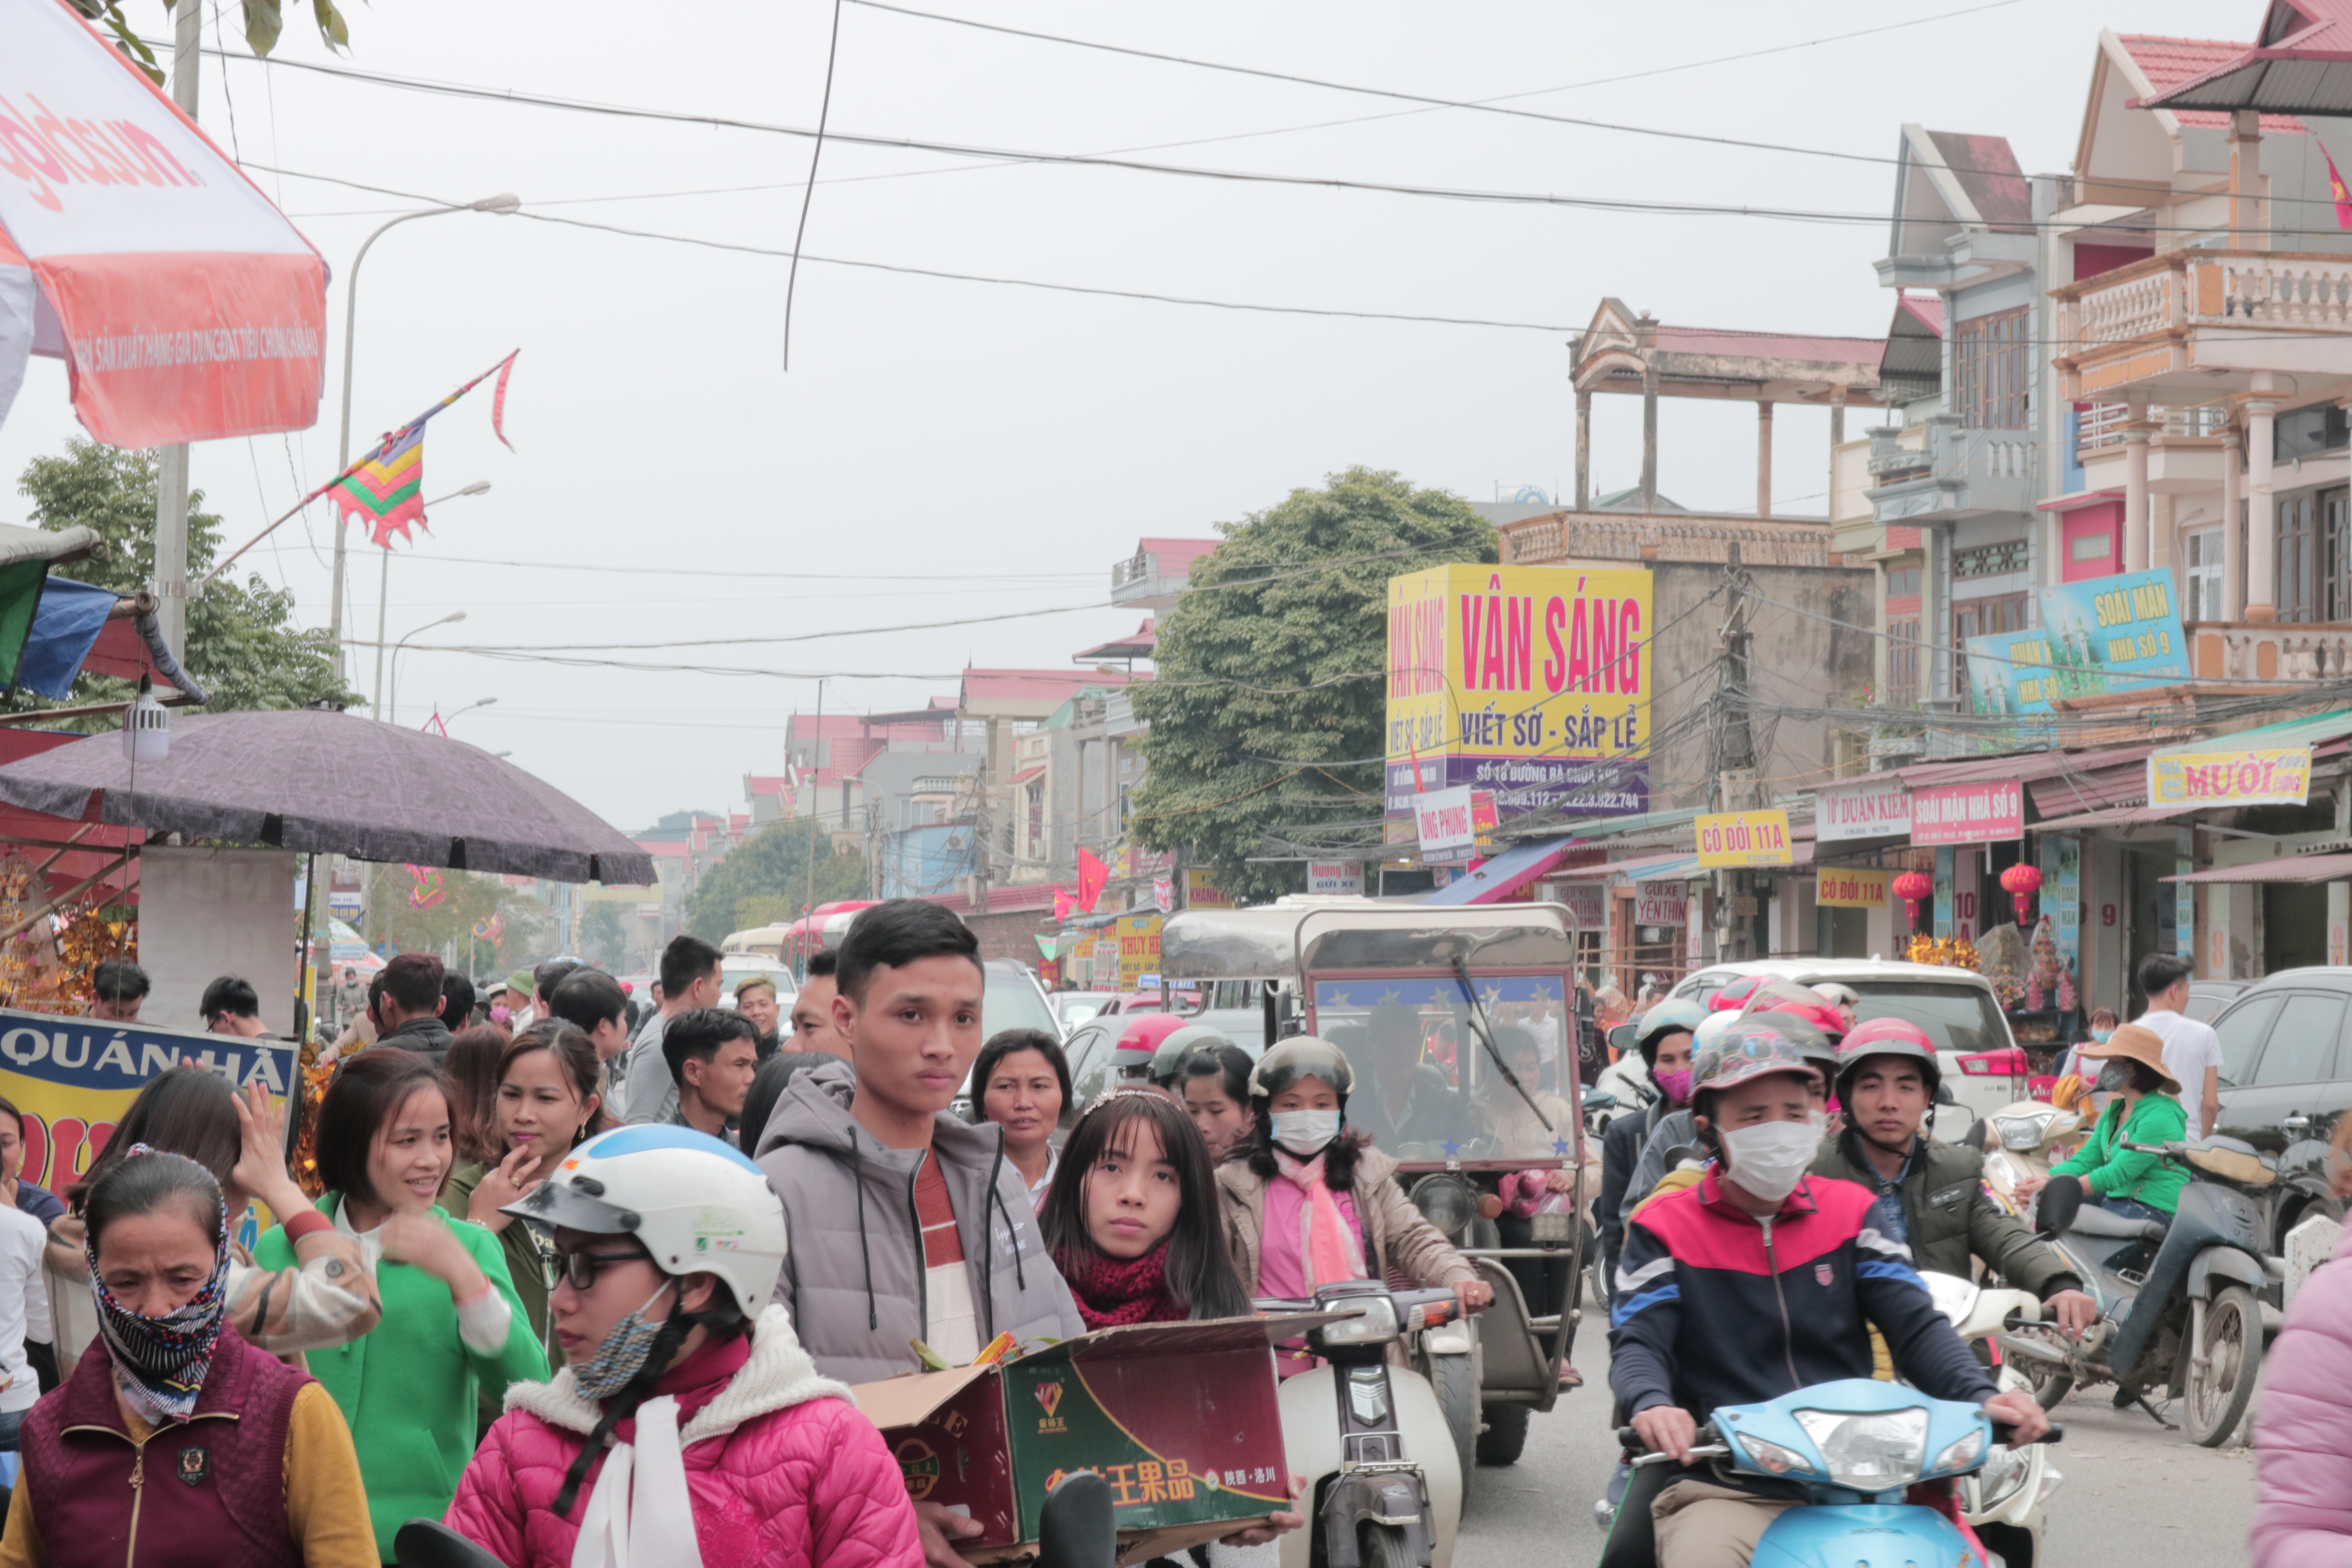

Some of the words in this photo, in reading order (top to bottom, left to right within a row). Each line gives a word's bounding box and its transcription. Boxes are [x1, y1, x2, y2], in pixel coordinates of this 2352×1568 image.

[2094, 584, 2132, 628] SOÁI
[2131, 579, 2170, 624] MẬN
[1390, 584, 1412, 700] VÂN
[1414, 578, 1444, 697] SÁNG
[1460, 573, 1532, 691] VÂN
[1544, 575, 1641, 695] SÁNG
[2107, 634, 2138, 663] NHÀ
[2138, 626, 2158, 658] SỐ
[2159, 631, 2170, 655] 9
[1461, 701, 1506, 746] VIẾT
[1513, 704, 1543, 747] SỚ
[1564, 704, 1606, 749] SẮP
[1613, 703, 1637, 750] LỄ
[1510, 762, 1546, 782] ĐƯỜNG
[2185, 752, 2276, 797] MƯỜI
[1421, 806, 1439, 840] ÔNG
[1438, 804, 1468, 843] PHỤNG
[1841, 788, 1875, 824] DUÂN
[1878, 784, 1909, 820] KIÊM
[1916, 794, 1940, 824] SOÁI
[1942, 792, 1966, 828] MẬN
[1969, 789, 1991, 821] NHÀ
[1993, 784, 2008, 818] SỐ
[2010, 792, 2018, 817] 9
[1702, 822, 1722, 853] CÔ
[1755, 824, 1784, 850] 11A
[1190, 885, 1218, 904] KHÁNH
[1638, 896, 1661, 921] YÊN
[1663, 885, 1678, 897] XE
[1822, 876, 1836, 899] CÔ
[1863, 883, 1883, 902] 11A
[1955, 892, 1975, 919] 10
[2102, 903, 2116, 926] 9
[2212, 929, 2224, 969] 8
[1, 1030, 180, 1076] QUÁN
[1045, 1458, 1195, 1508] 王果品
